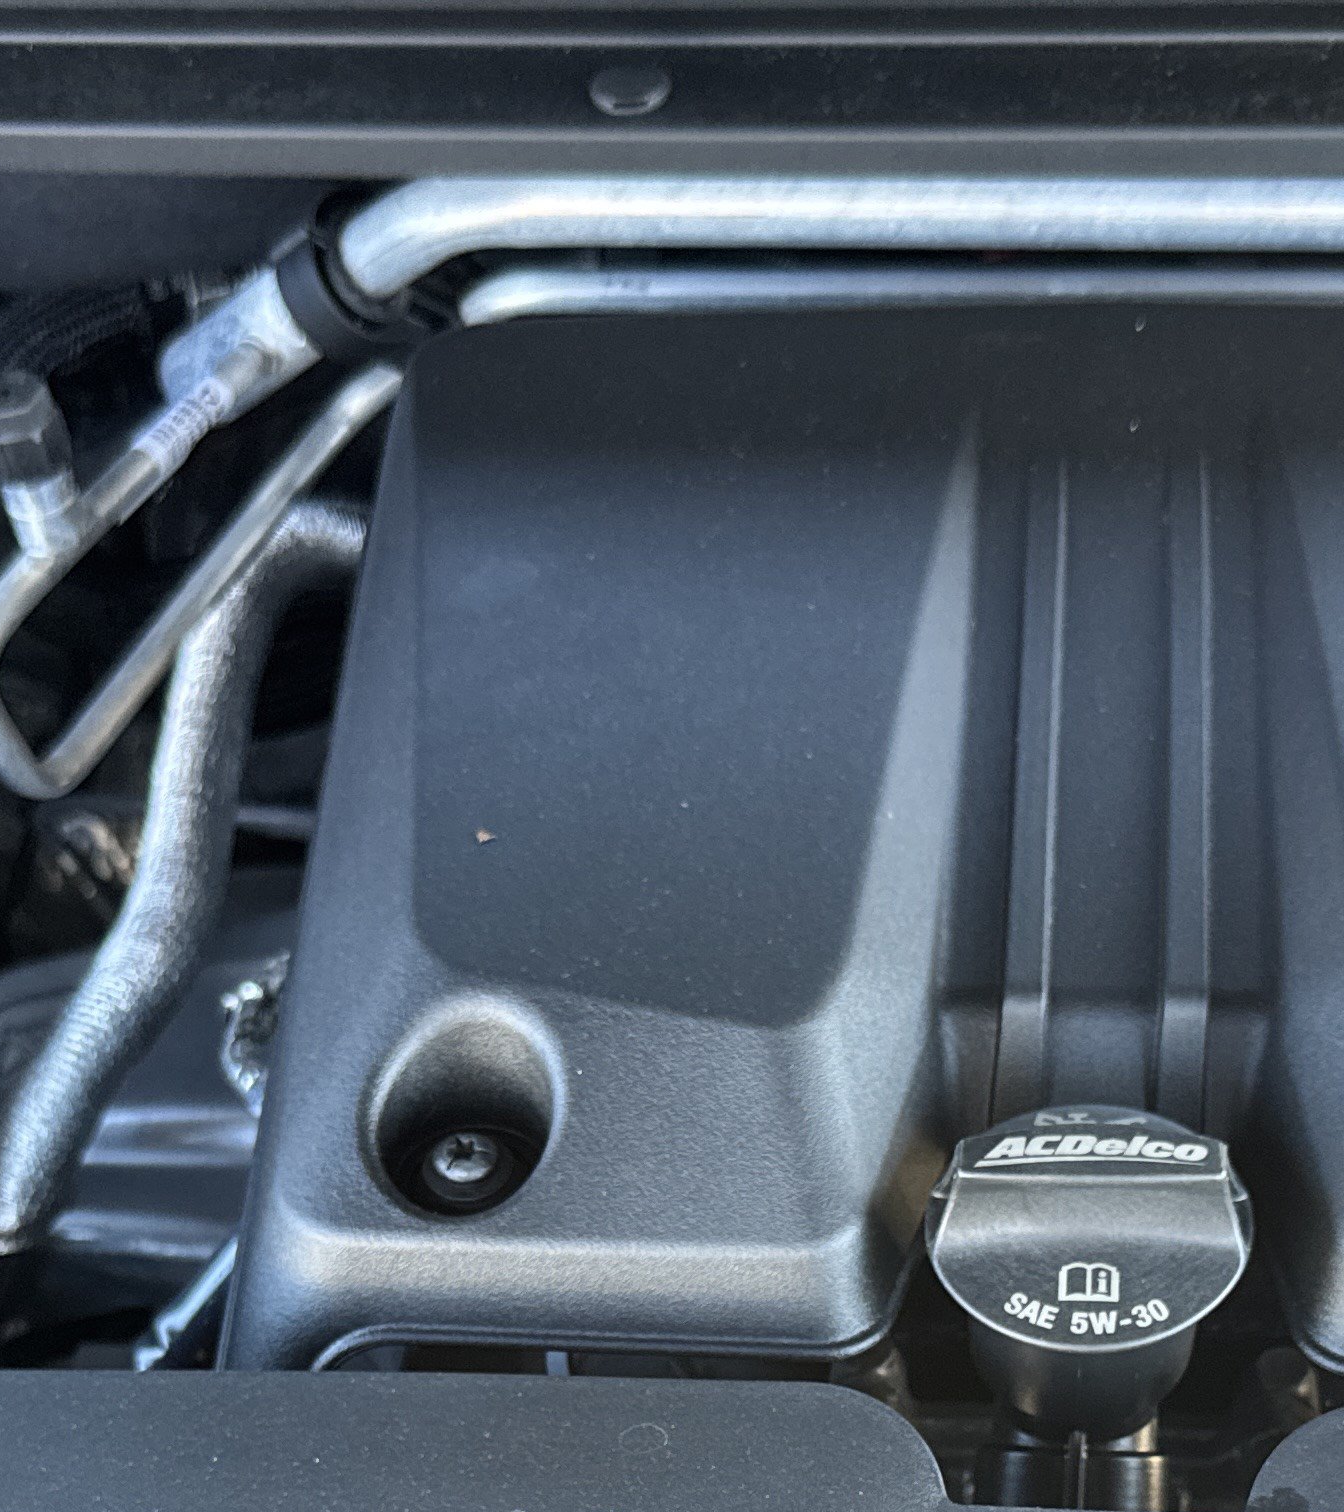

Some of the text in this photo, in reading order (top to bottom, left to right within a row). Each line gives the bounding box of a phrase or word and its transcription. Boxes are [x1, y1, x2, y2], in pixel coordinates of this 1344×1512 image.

[983, 1135, 1210, 1160] ACDelco
[1003, 1291, 1170, 1336] SAE 5W-30
